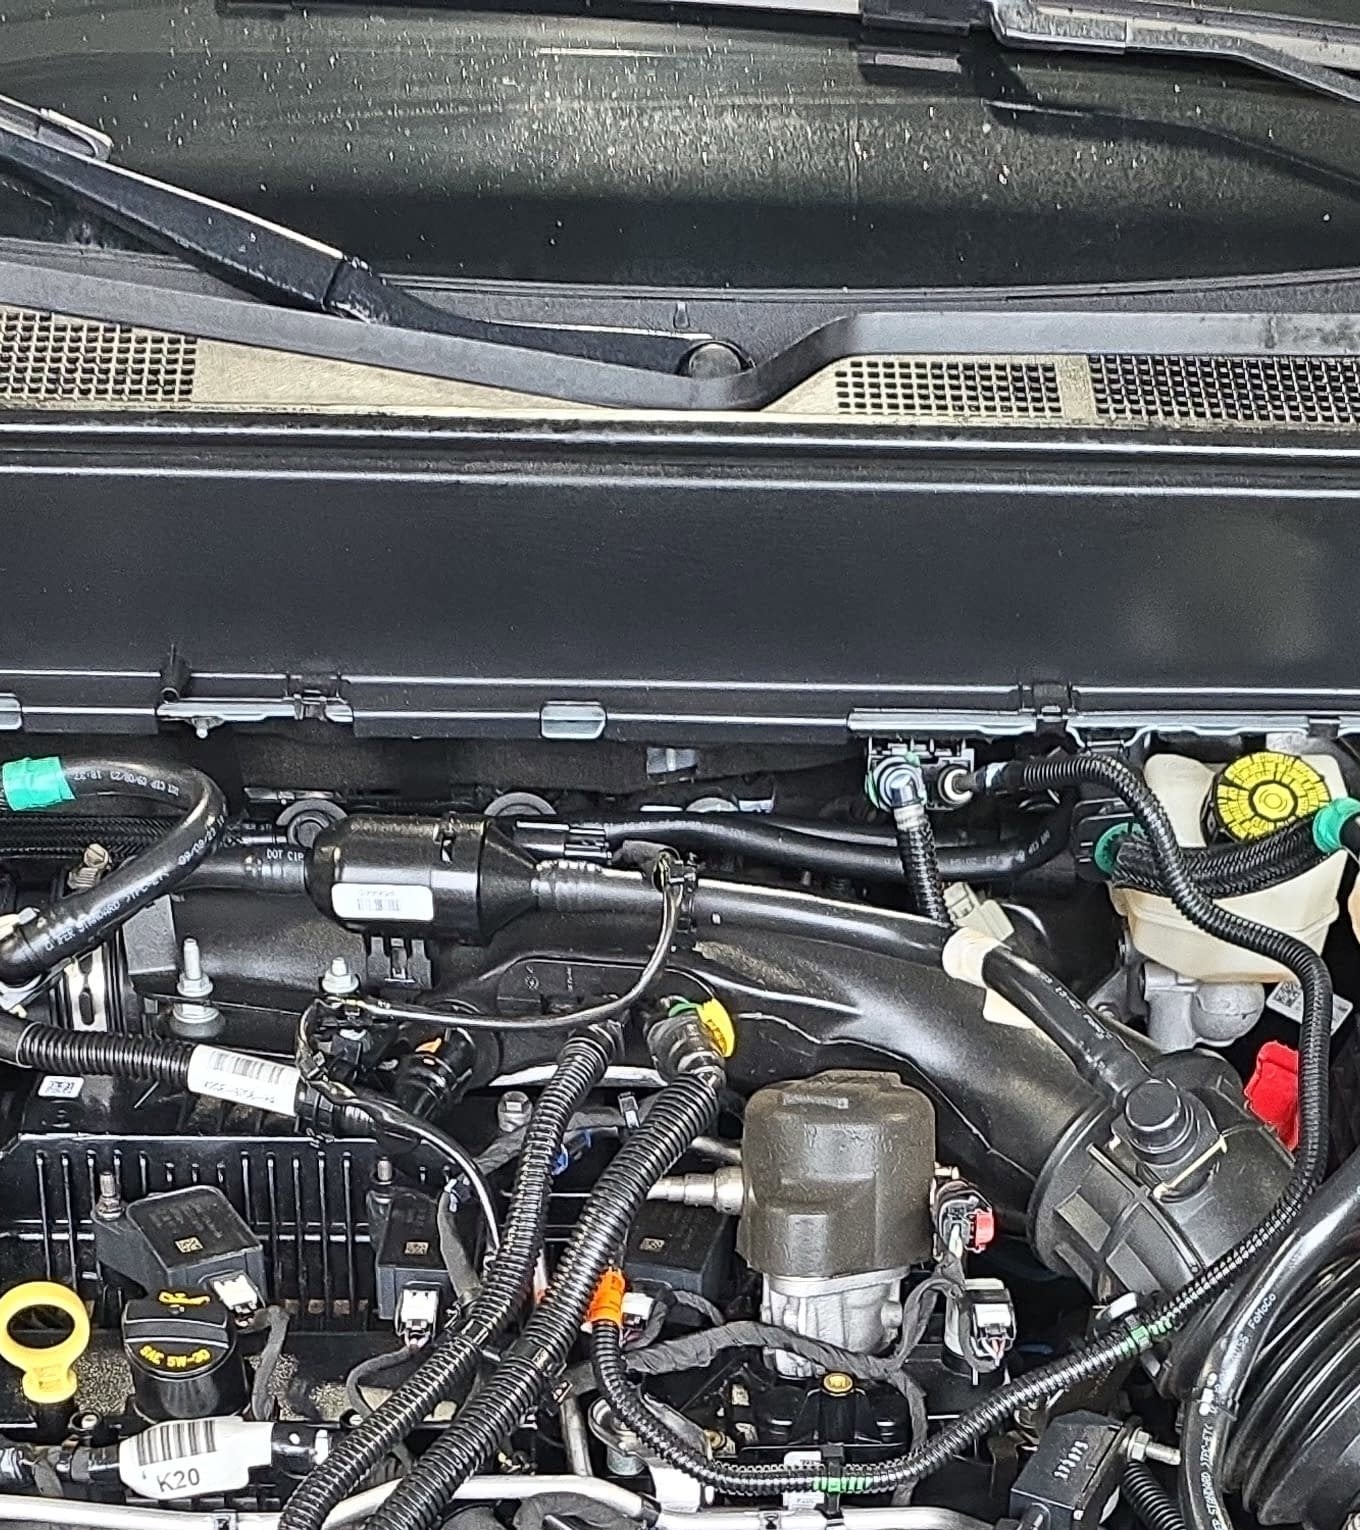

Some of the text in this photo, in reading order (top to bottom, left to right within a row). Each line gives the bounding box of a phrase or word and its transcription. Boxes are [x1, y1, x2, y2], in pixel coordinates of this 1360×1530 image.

[266, 848, 283, 860] DOT
[1248, 1292, 1277, 1330] FoMoCo
[140, 1345, 164, 1365] SAE
[157, 1468, 200, 1492] K20
